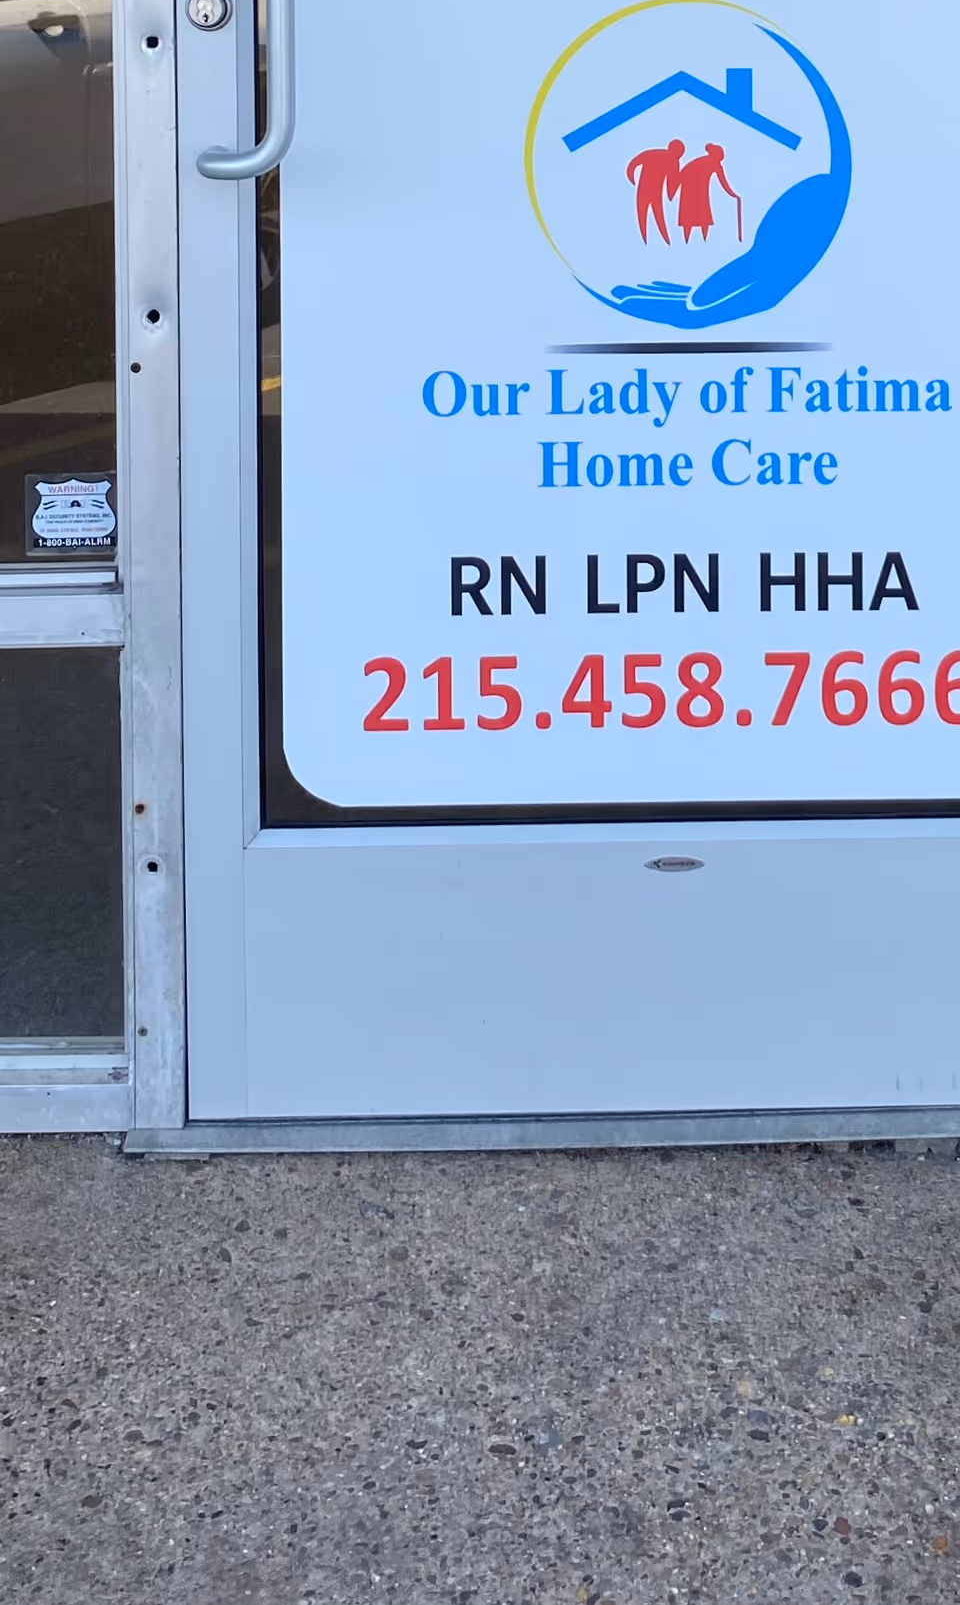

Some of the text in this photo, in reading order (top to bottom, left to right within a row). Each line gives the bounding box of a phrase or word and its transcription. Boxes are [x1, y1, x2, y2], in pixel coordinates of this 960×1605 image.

[422, 365, 953, 428] Our Lady of Fatima
[48, 484, 99, 494] WARNING!
[537, 438, 839, 488] Home Care
[450, 551, 920, 616] RN LPN HHA
